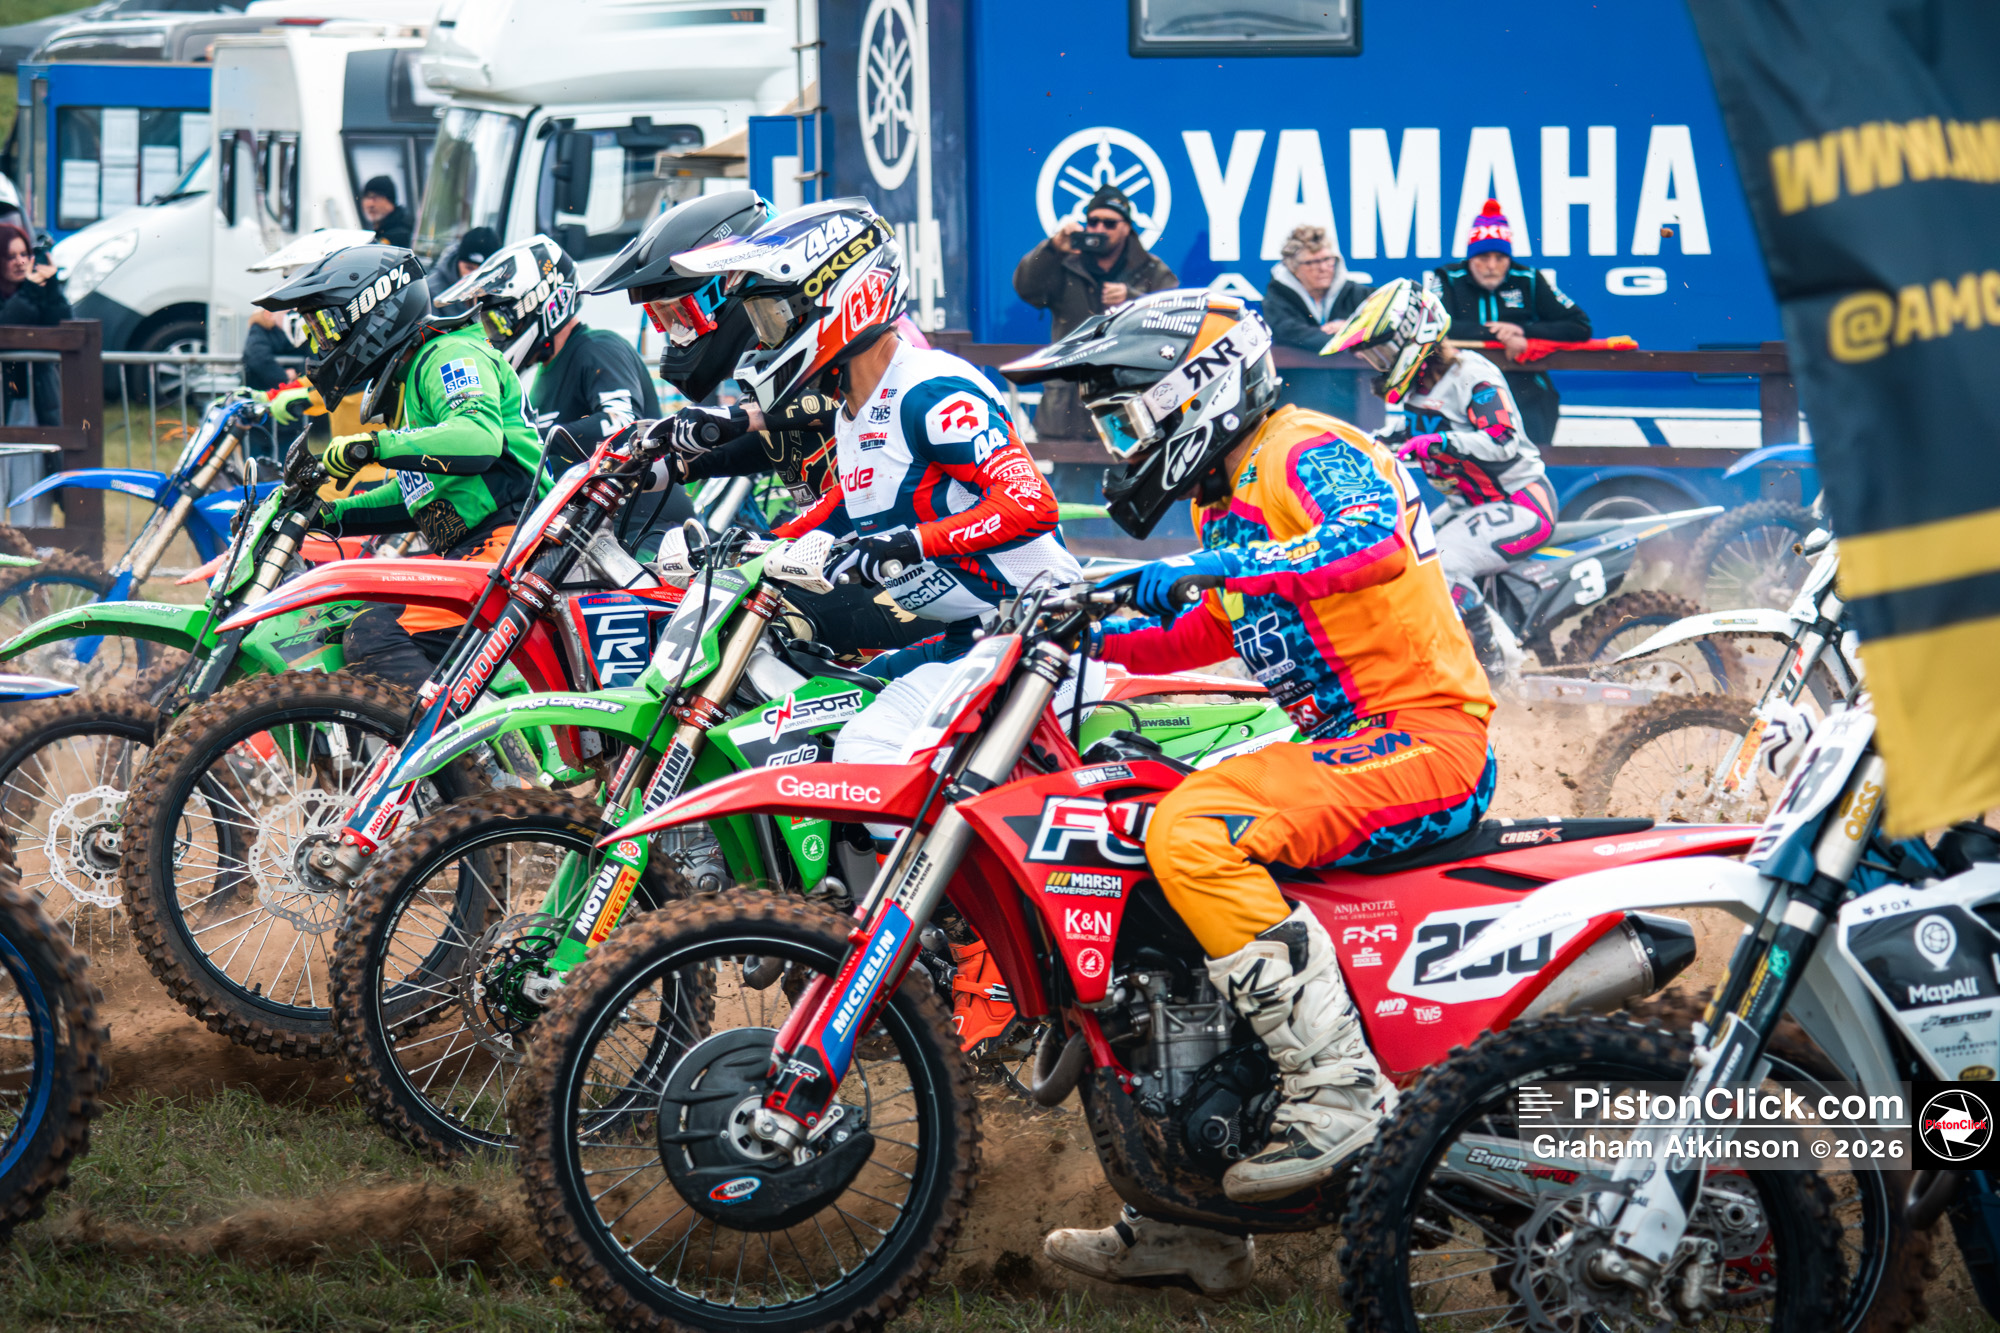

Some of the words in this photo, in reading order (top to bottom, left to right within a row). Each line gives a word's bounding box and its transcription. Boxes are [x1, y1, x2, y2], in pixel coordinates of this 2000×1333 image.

[1182, 125, 1711, 261] YAMAHA
[805, 215, 849, 262] 44
[803, 230, 876, 298] OAKLEY
[346, 264, 410, 324] 100%
[513, 267, 564, 321] 100%
[445, 375, 480, 395] SCS
[869, 404, 891, 421] TWS
[858, 431, 888, 443] TECHNICAL
[973, 427, 1008, 465] 44
[590, 491, 610, 507] ROCS
[949, 513, 1001, 543] ride
[1465, 505, 1514, 537] FLY
[713, 572, 745, 585] CLAYTON
[1569, 557, 1607, 606] 3
[520, 589, 544, 609] ROCS
[588, 595, 632, 605] Honda
[754, 602, 774, 618] ROCS
[278, 632, 317, 650] 450
[597, 613, 646, 684] CRF
[452, 616, 521, 712] SHOWA
[506, 698, 548, 713] PRO
[549, 697, 626, 714] CIRCUIT
[431, 719, 497, 760] missionmx
[671, 756, 693, 796] SUSPENSION
[776, 775, 881, 804] Geartec
[1076, 768, 1107, 785] SDW
[369, 801, 395, 835] MOTUL
[1045, 885, 1122, 898] POWERSPORTS
[1071, 872, 1122, 890] MARSH
[574, 862, 620, 937] MOTUL
[591, 870, 637, 943] PIRELLI
[1334, 902, 1360, 915] ANJA
[1361, 899, 1396, 912] POTZE
[1880, 898, 1913, 913] FOX
[1066, 908, 1112, 936] K&N
[1343, 924, 1397, 945] FXR
[1099, 935, 1111, 943] LTD
[832, 929, 896, 1035] MICHELIN
[1908, 976, 1980, 1005] MapAll
[1413, 1006, 1442, 1021] TWS
